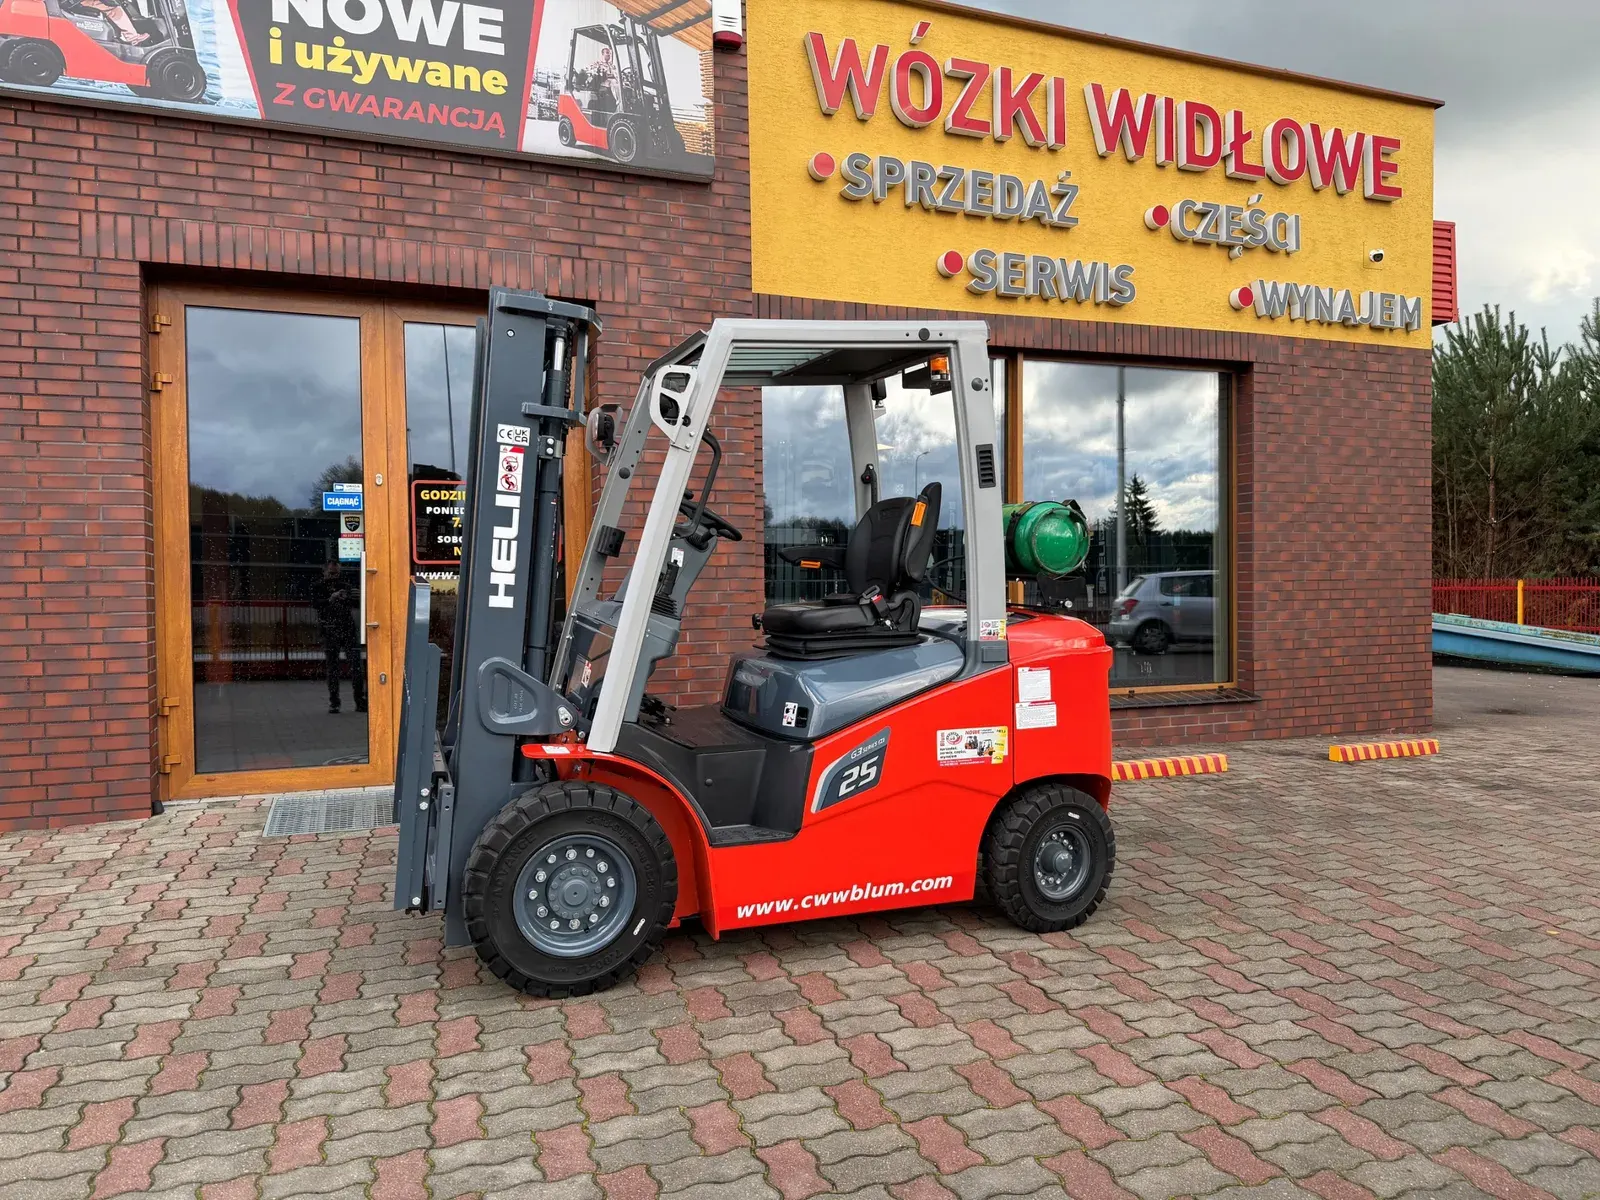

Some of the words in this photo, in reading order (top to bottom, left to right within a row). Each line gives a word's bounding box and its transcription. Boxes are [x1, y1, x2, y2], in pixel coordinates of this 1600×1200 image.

[269, 27, 282, 65] i
[295, 36, 508, 95] używane
[272, 82, 297, 106] Z
[303, 87, 506, 138] GWARANCJĄ
[804, 21, 1066, 150] WÓZKI
[1083, 82, 1403, 202] WIDŁOWE
[840, 152, 1079, 228] SPRZEDAŻ
[1169, 193, 1301, 259] CZĘŚCI
[966, 249, 1136, 305] SERWIS
[1251, 278, 1422, 331] WYNAJEM
[327, 496, 359, 507] CIĄGNĄĆ
[488, 493, 520, 608] HELI
[838, 755, 879, 797] 25
[736, 874, 953, 919] www.cwwblum.com
